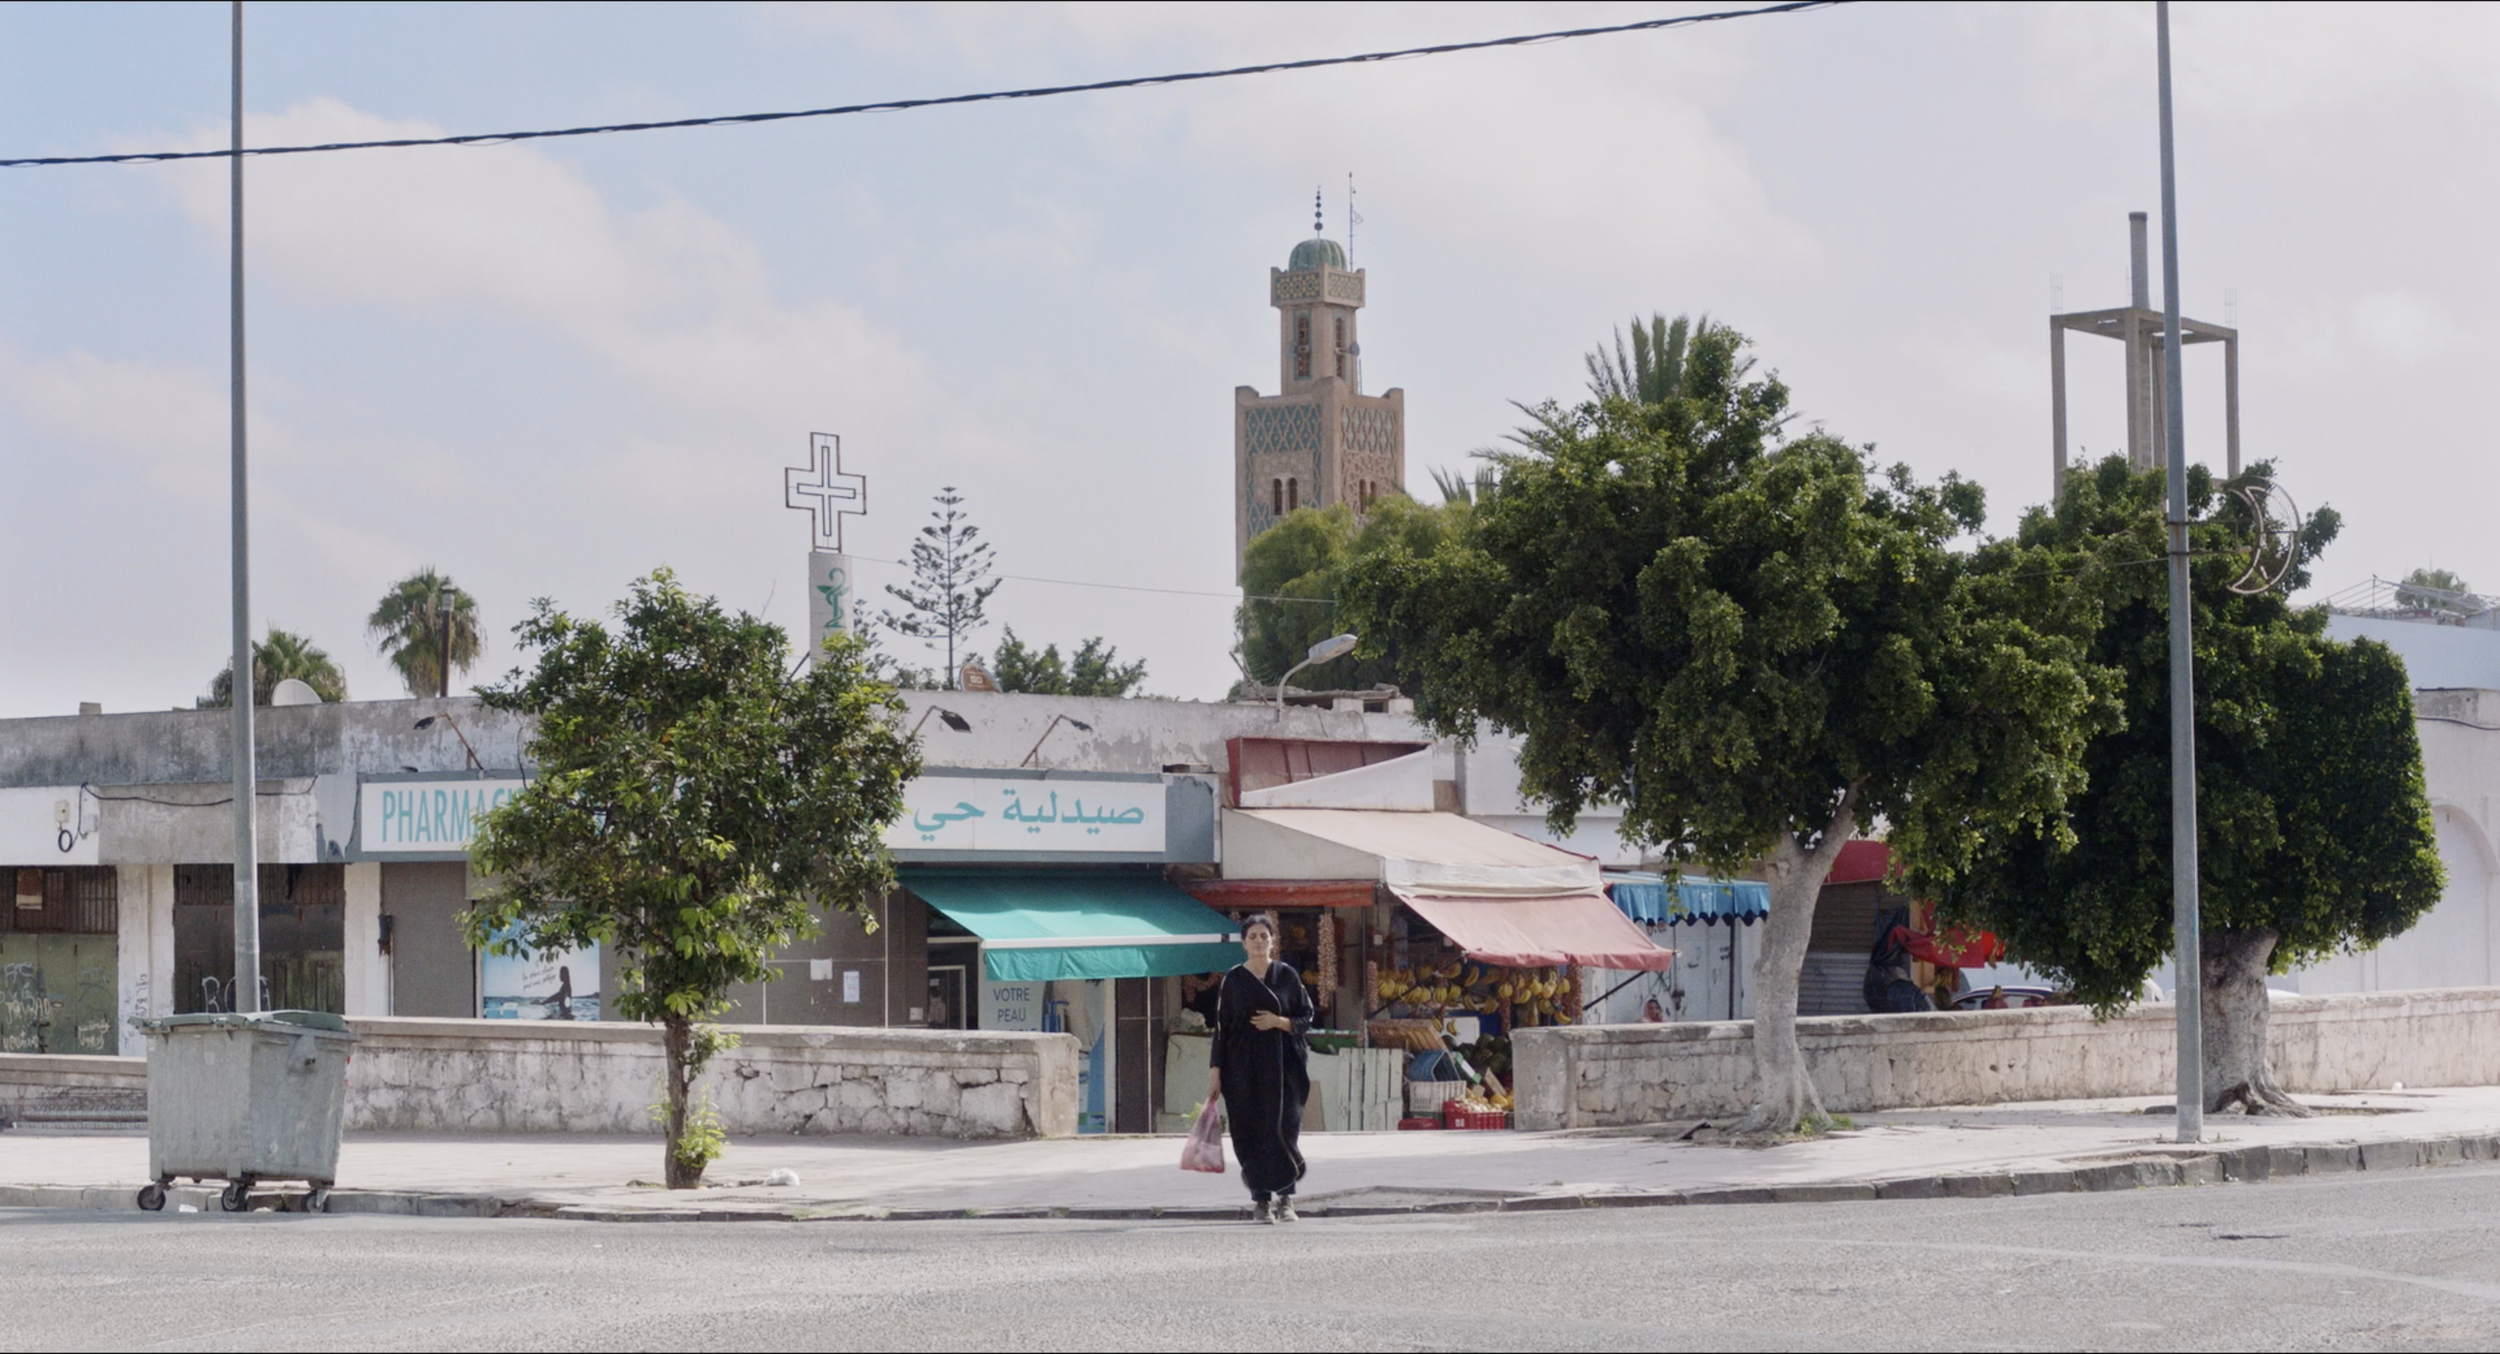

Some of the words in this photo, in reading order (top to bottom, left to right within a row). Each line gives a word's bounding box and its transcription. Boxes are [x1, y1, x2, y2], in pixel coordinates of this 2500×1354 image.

[382, 787, 526, 842] PHARMA
[914, 801, 986, 842] حي
[1003, 788, 1145, 835] صيدلية
[993, 988, 1030, 1002] VOTRE
[998, 1008, 1026, 1022] PEAU
